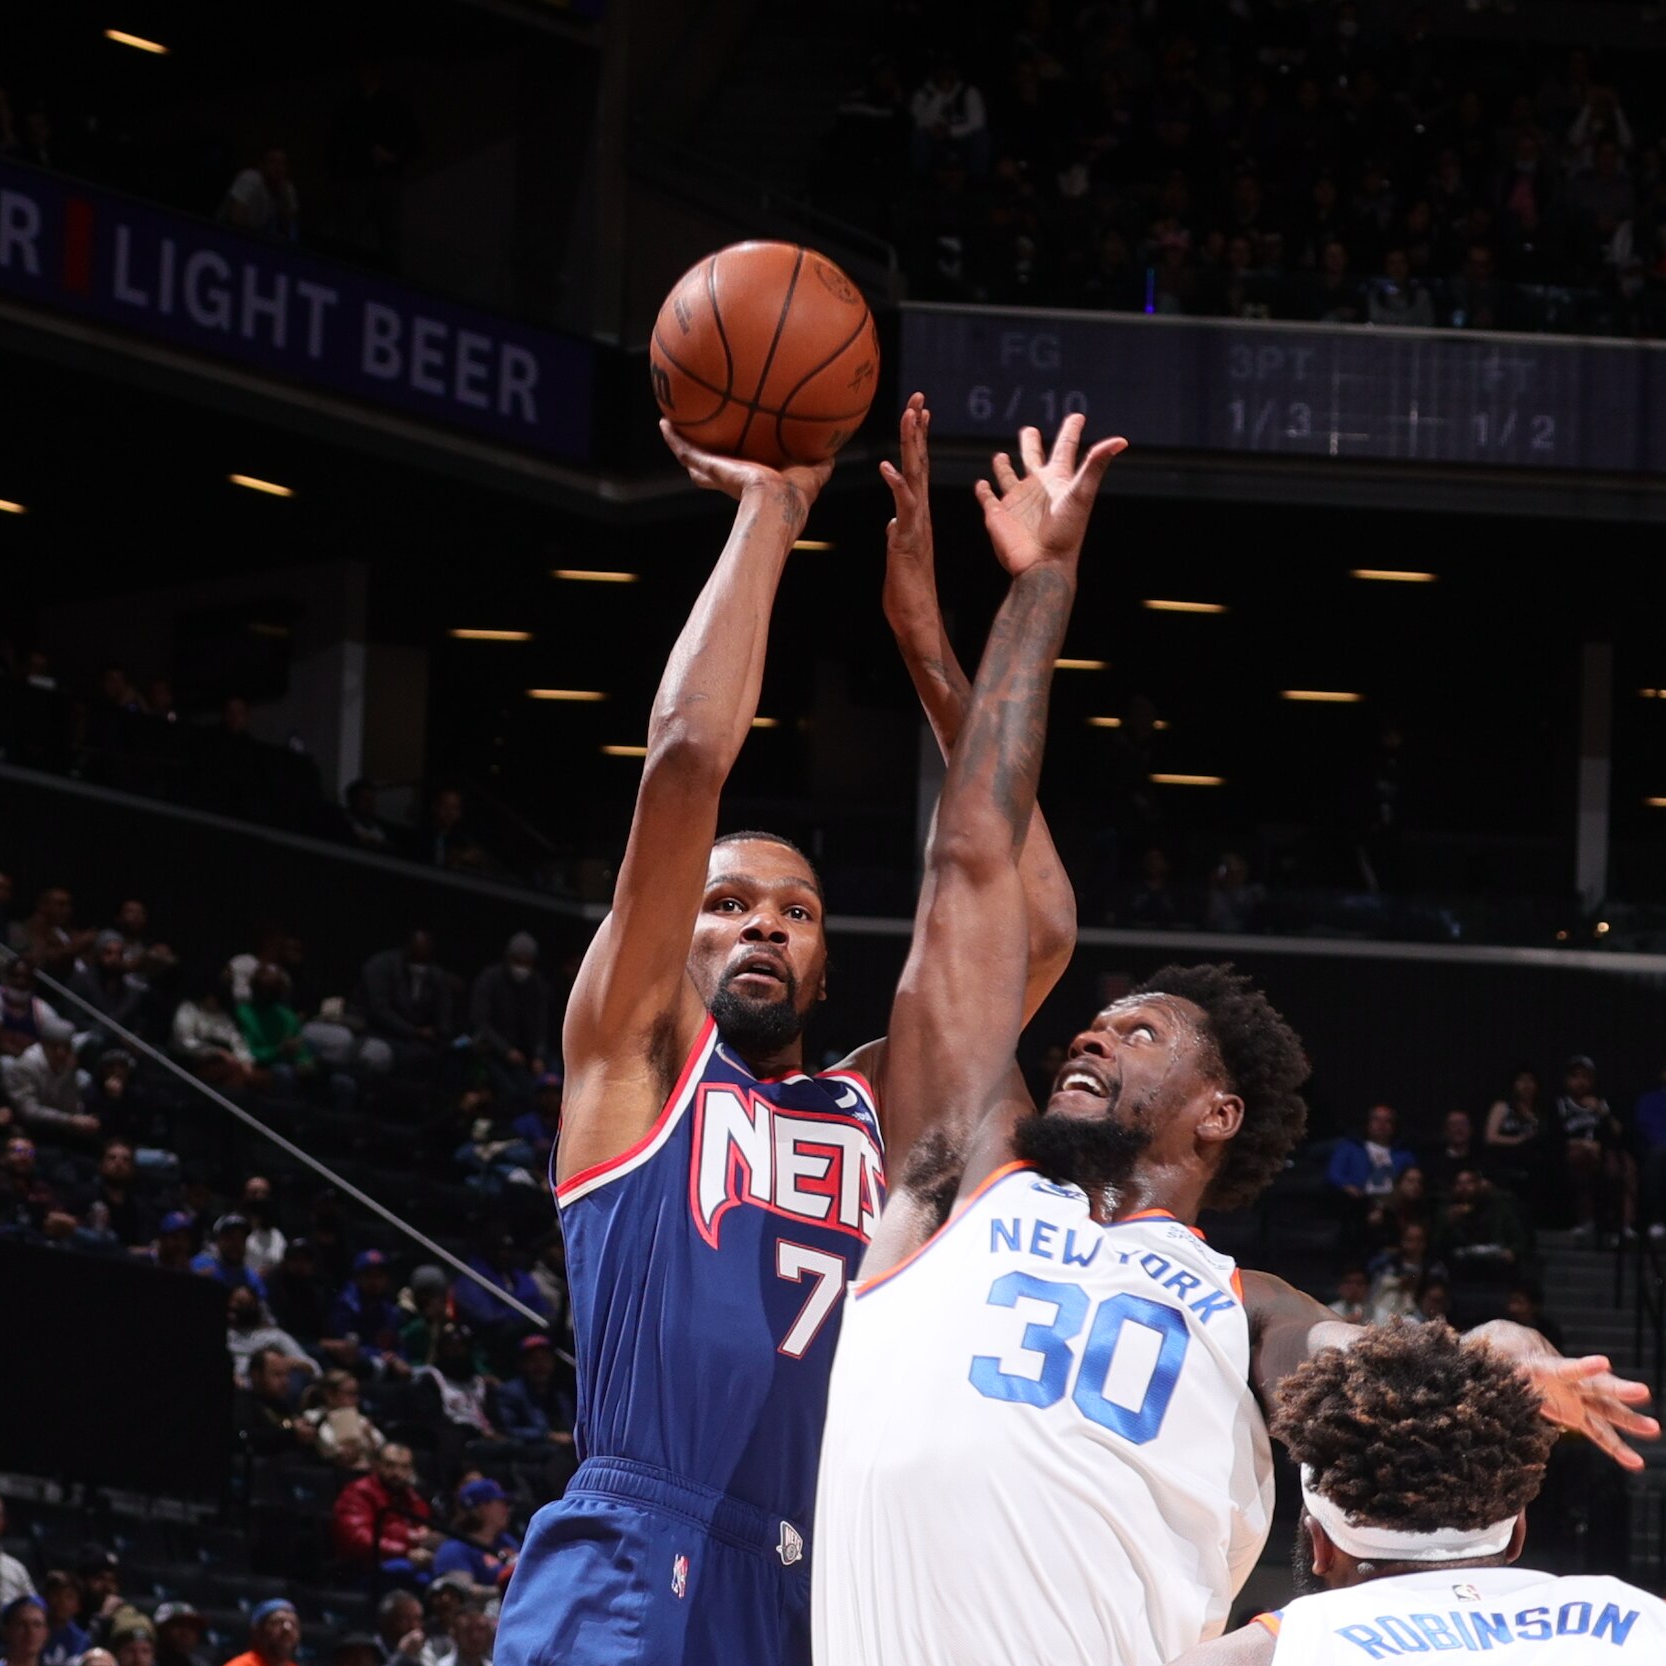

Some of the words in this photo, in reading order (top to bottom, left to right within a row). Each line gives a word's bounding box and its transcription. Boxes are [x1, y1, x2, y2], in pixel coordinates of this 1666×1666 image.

[111, 222, 341, 361] LIGHT
[359, 300, 542, 427] BEER
[1001, 332, 1062, 371] FG
[1230, 344, 1317, 380] 3PT
[990, 1217, 1103, 1268] NEW
[775, 1238, 847, 1358] 7
[968, 1271, 1190, 1446] 30
[1334, 1600, 1641, 1660] ROBINSON
